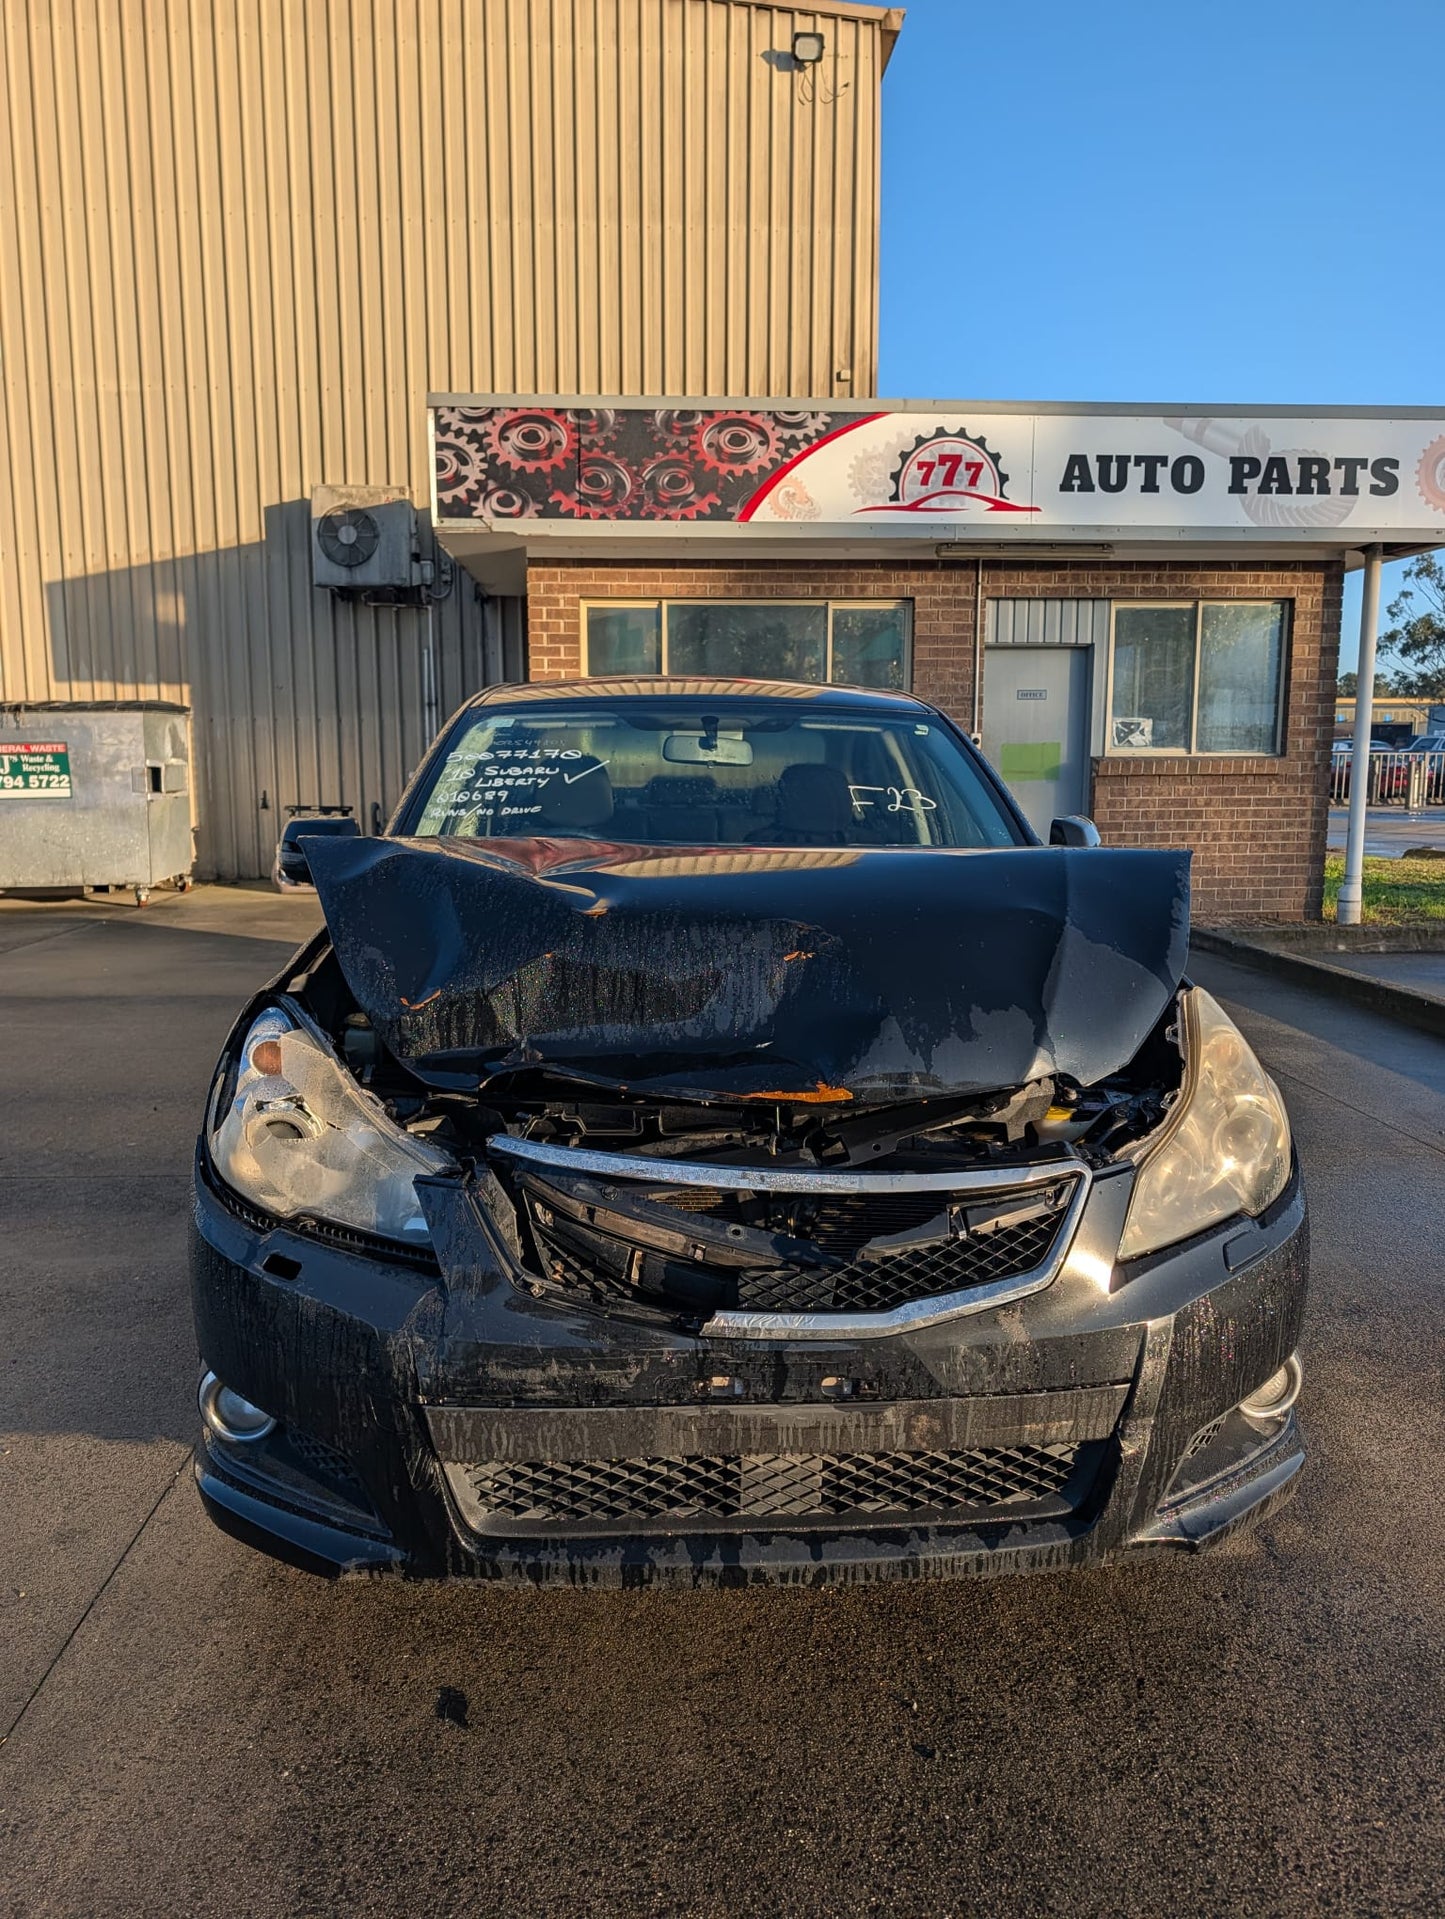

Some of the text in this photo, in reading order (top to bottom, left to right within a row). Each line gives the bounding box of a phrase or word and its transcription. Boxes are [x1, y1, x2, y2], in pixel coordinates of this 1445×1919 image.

[916, 453, 984, 487] 777
[1059, 454, 1400, 496] AUTO PARTS
[30, 744, 66, 752] WASTE
[20, 754, 44, 763] Waste
[22, 763, 60, 773] Recycling
[29, 774, 70, 788] 5722
[475, 777, 550, 788] LIBERTY
[501, 805, 542, 816] DRIVE
